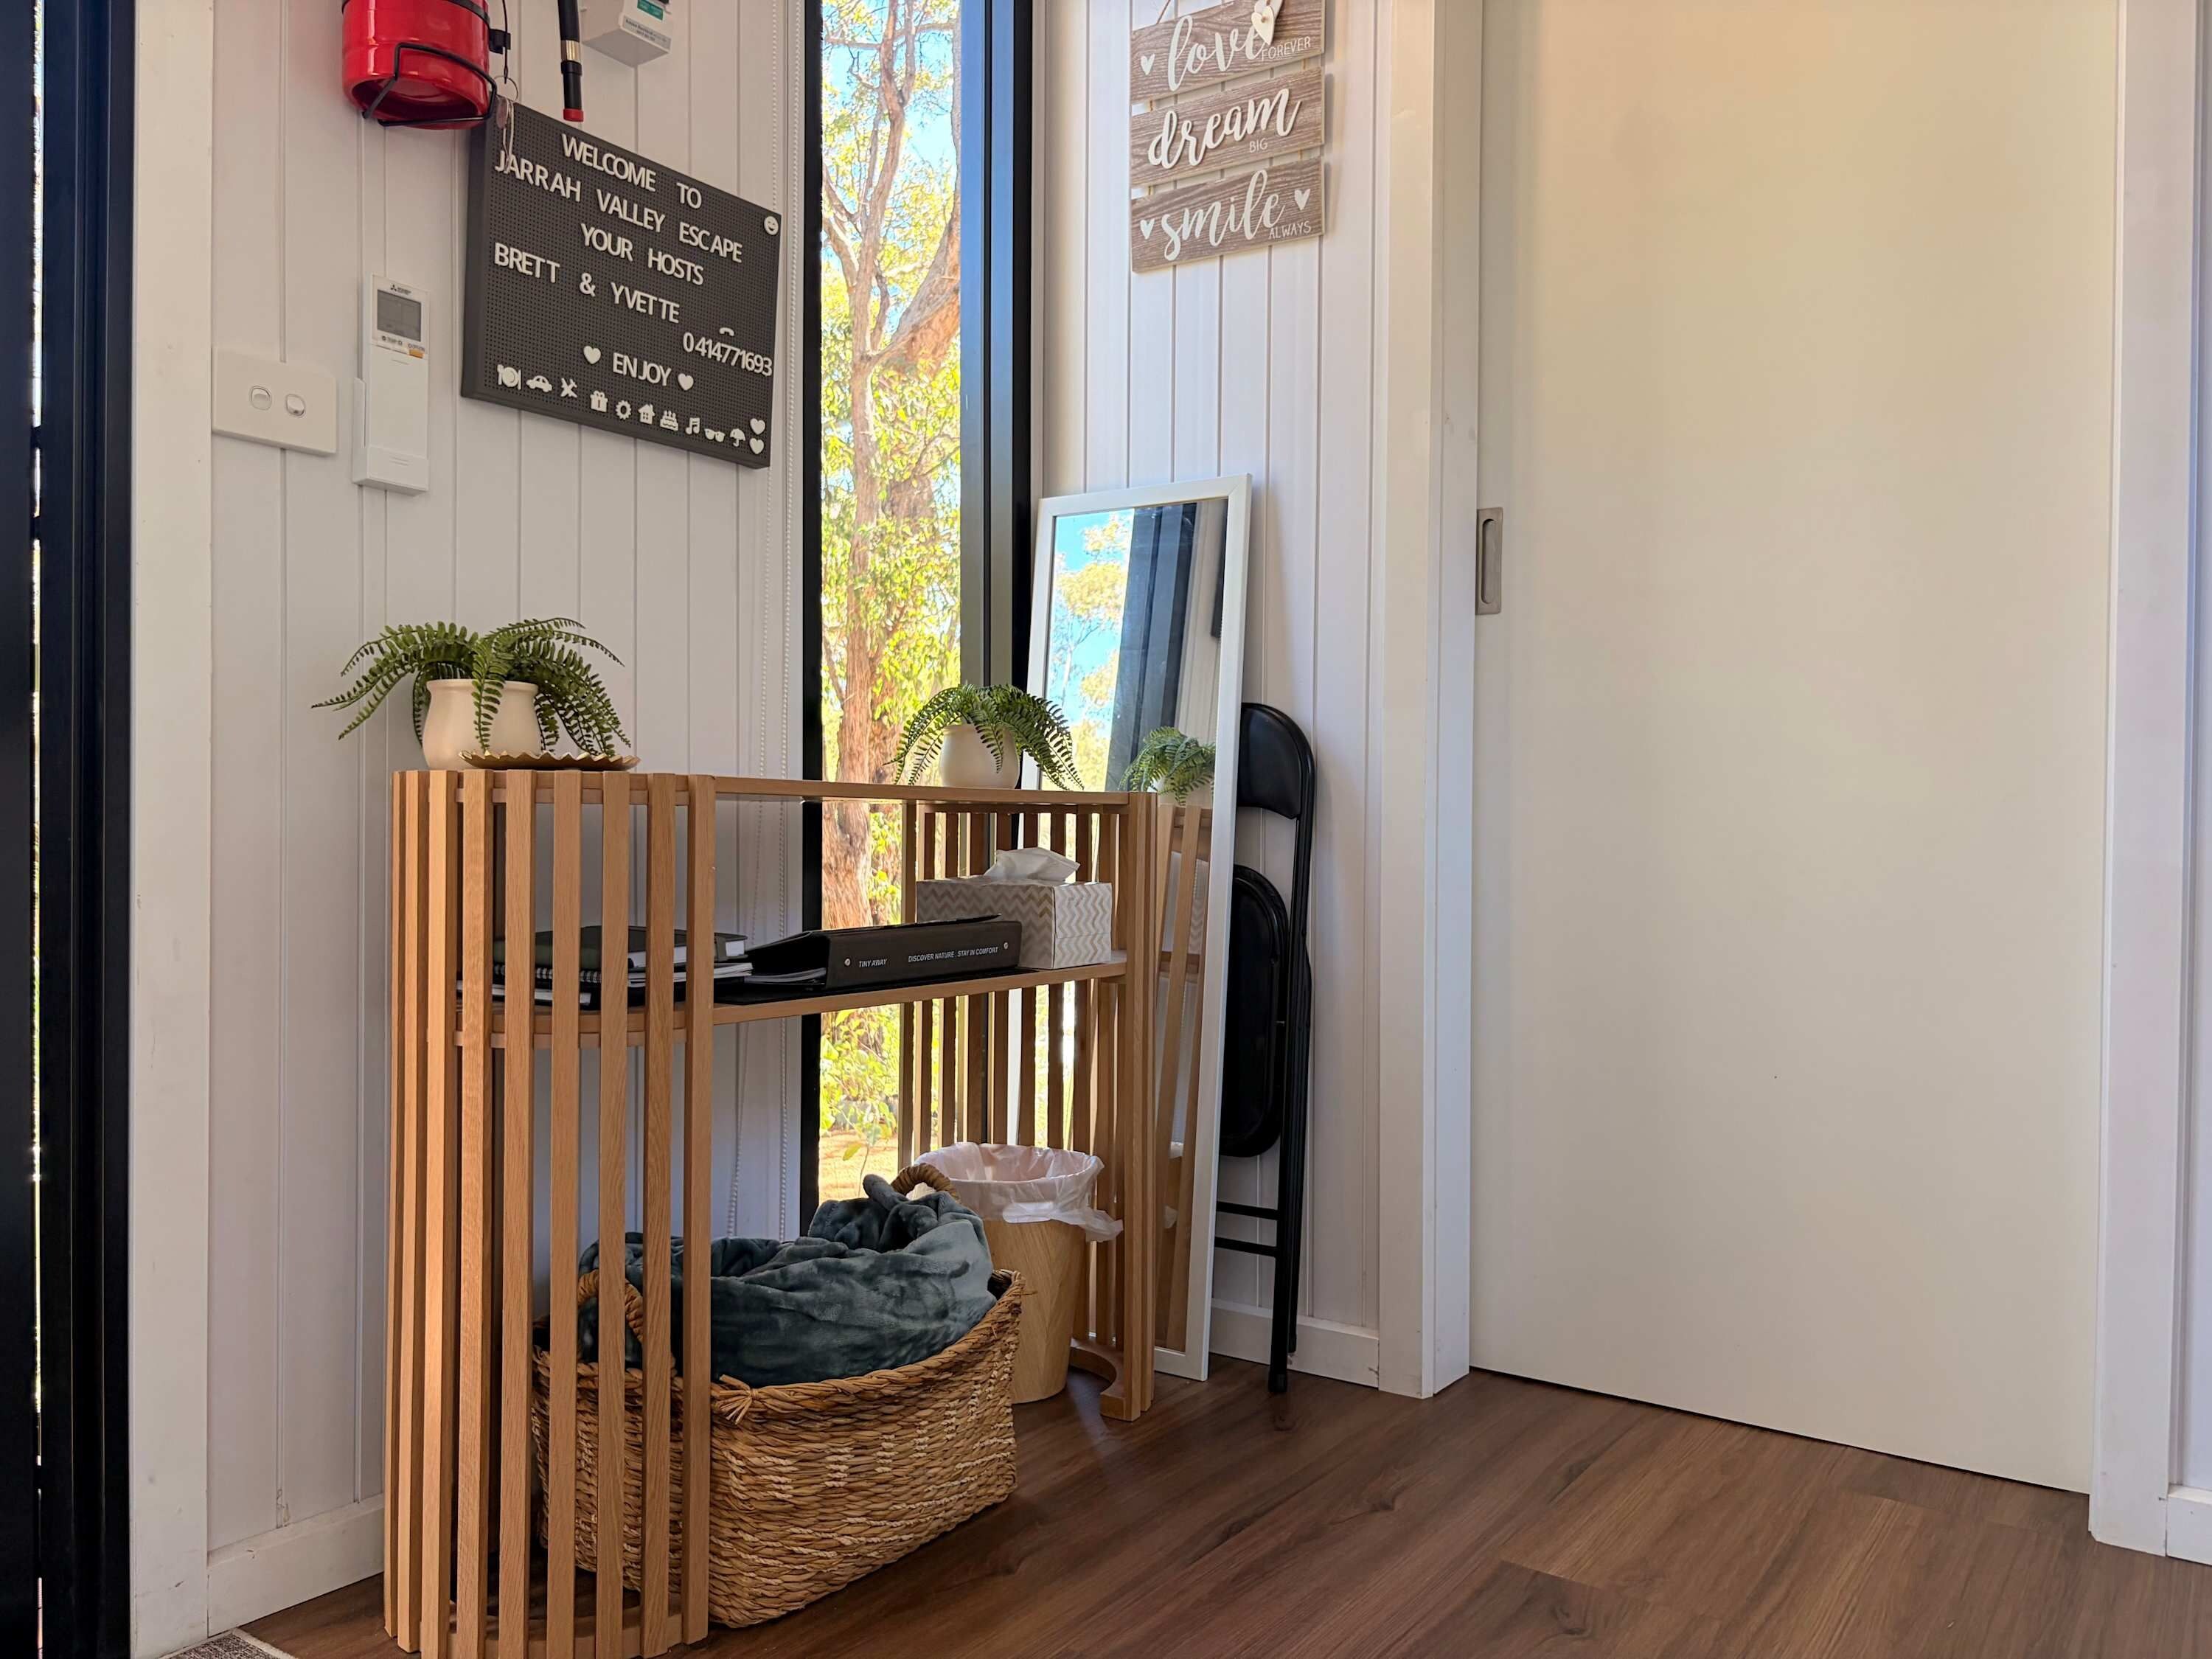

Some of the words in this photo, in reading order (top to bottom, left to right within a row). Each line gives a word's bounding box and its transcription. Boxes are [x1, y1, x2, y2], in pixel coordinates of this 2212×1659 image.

[1168, 15, 1267, 91] love
[1262, 36, 1311, 60] FOREVER
[1148, 88, 1302, 169] dream
[1250, 141, 1268, 153] BIG
[562, 133, 656, 192] WELCOME
[677, 182, 702, 209] TO
[495, 150, 581, 203] JARRAH
[597, 189, 665, 233] VALLEY
[679, 222, 742, 262] ESCAPE
[1161, 169, 1286, 261] smile
[1269, 221, 1312, 240] ALWAYS
[581, 223, 633, 262] YOUR
[647, 248, 704, 286] HOSTS
[494, 243, 560, 283] BRETT
[580, 272, 596, 296] &
[611, 282, 680, 323] YVETTE
[613, 352, 671, 387] ENJOY
[683, 332, 773, 377] 0414771693
[858, 959, 871, 967] TINY
[872, 959, 888, 967] AWAY
[908, 953, 934, 963] DISCOVER
[958, 948, 970, 957] STAY
[975, 947, 998, 956] COMFORT
